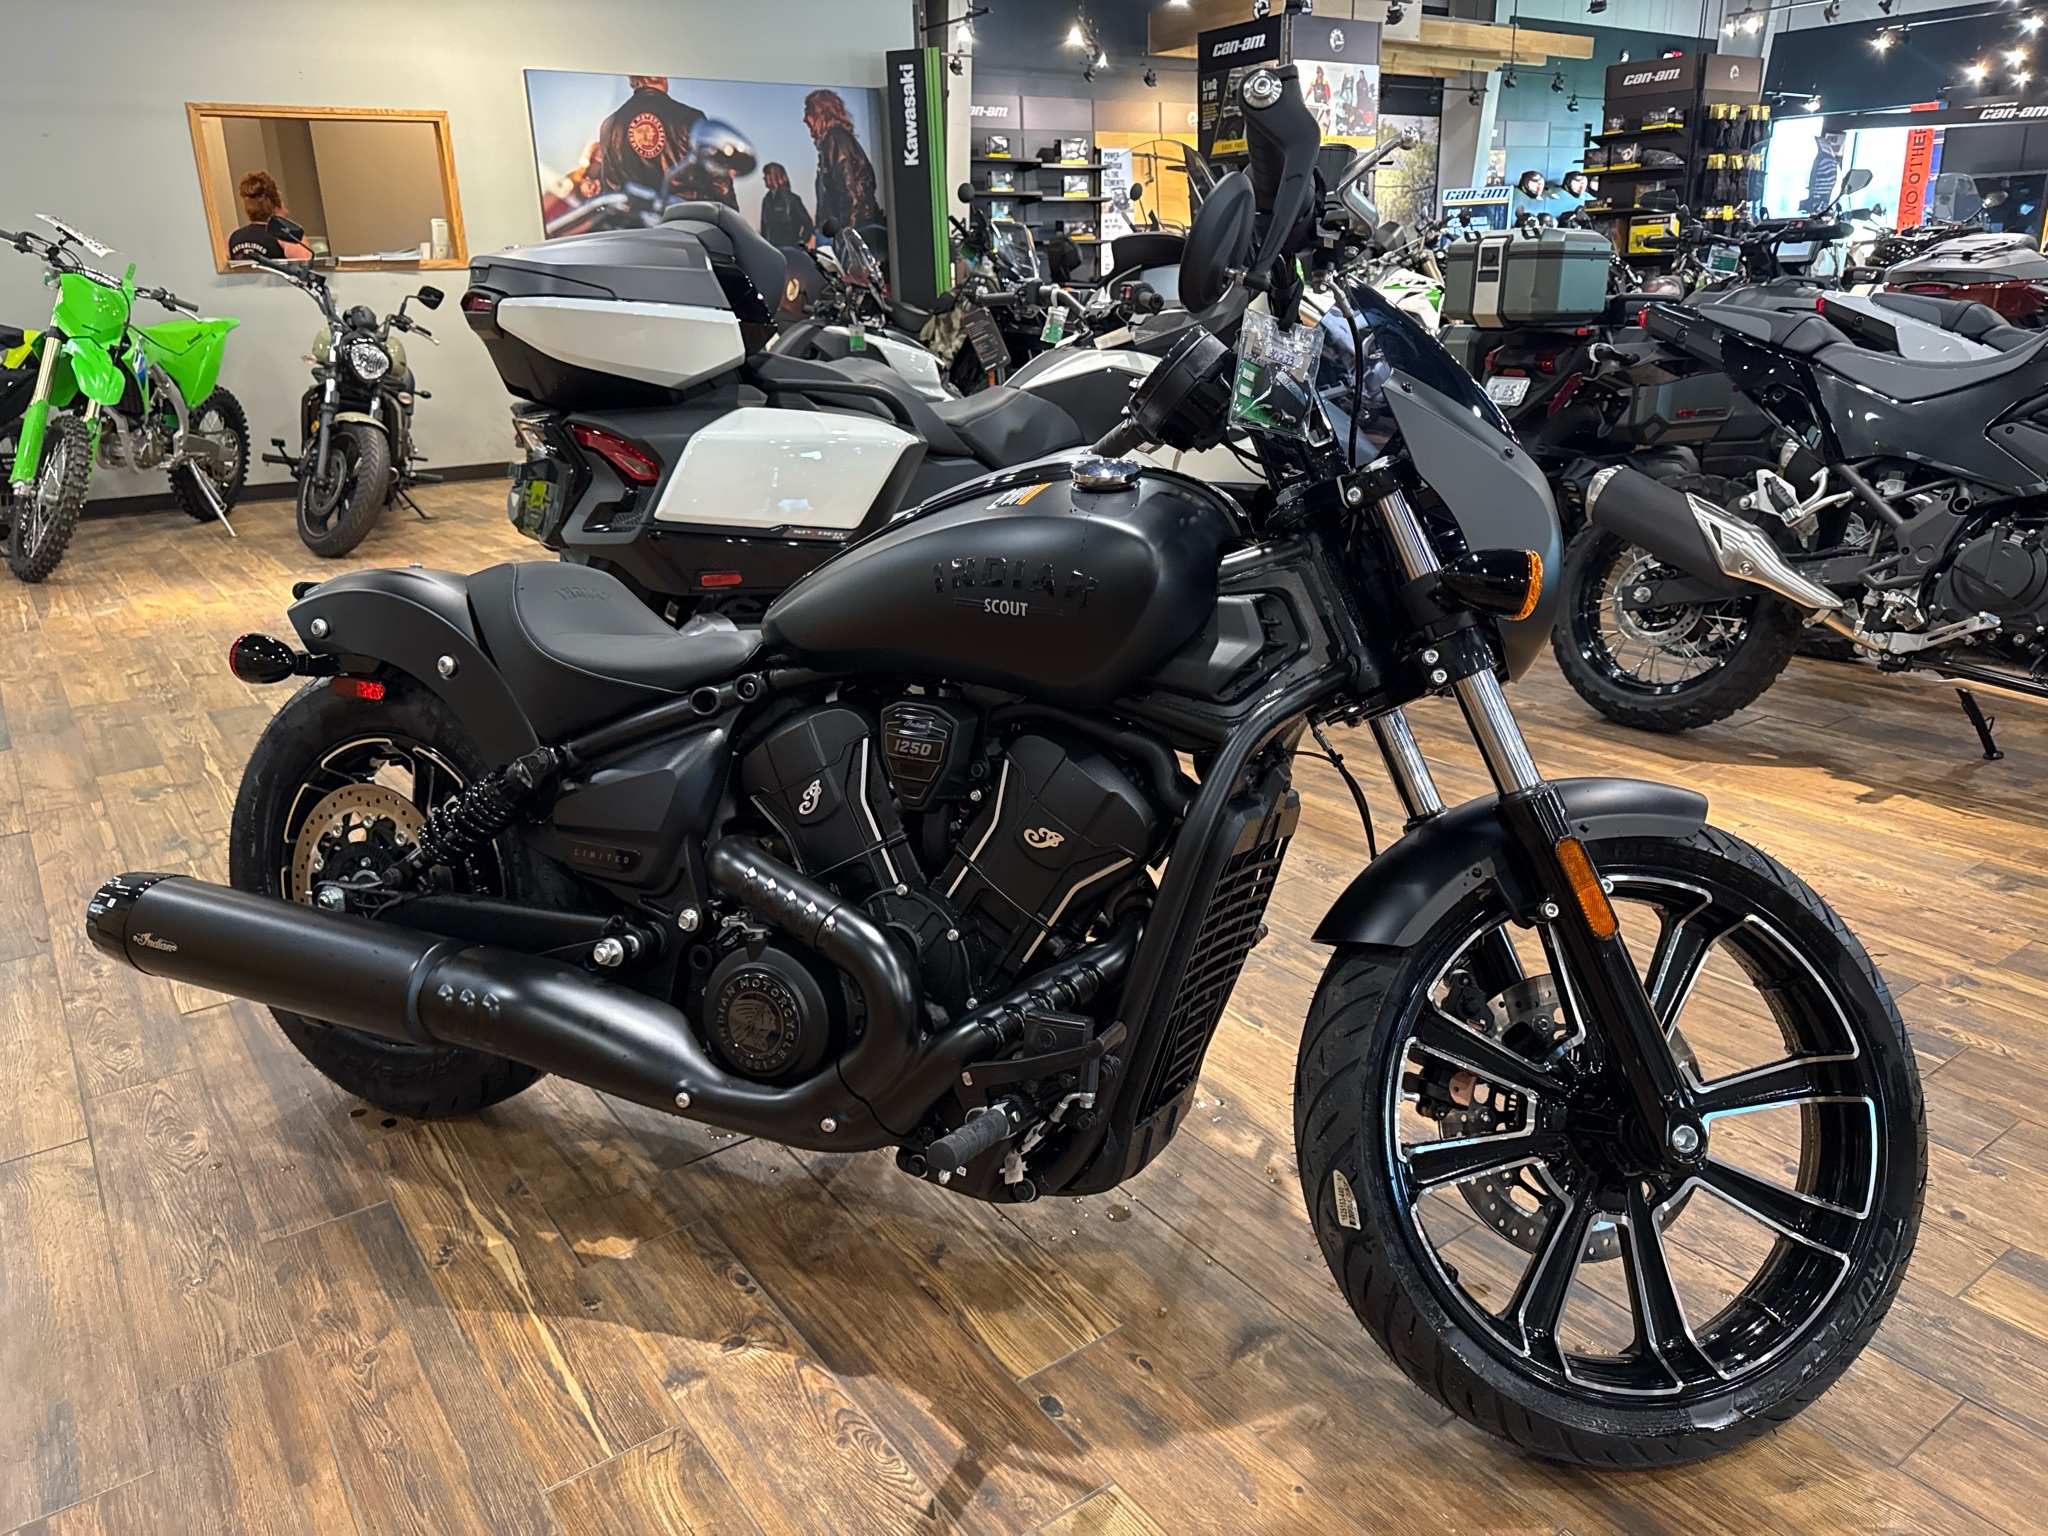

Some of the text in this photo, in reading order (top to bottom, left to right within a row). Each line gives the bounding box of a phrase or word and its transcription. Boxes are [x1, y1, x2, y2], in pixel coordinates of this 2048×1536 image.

[1212, 33, 1266, 57] can-am
[1623, 68, 1680, 86] can-am
[899, 63, 920, 166] Kawasaki
[970, 105, 1009, 118] an-am
[1445, 188, 1509, 200] can-am
[1904, 190, 1919, 217] NO
[793, 529, 843, 537] SPYDER
[932, 557, 1100, 608] INDIAN
[984, 598, 1029, 617] SCOUT
[894, 739, 932, 756] 1250
[574, 848, 630, 864] LIMITED
[132, 932, 178, 952] Indian
[739, 978, 796, 1059] MOTORCYCLE
